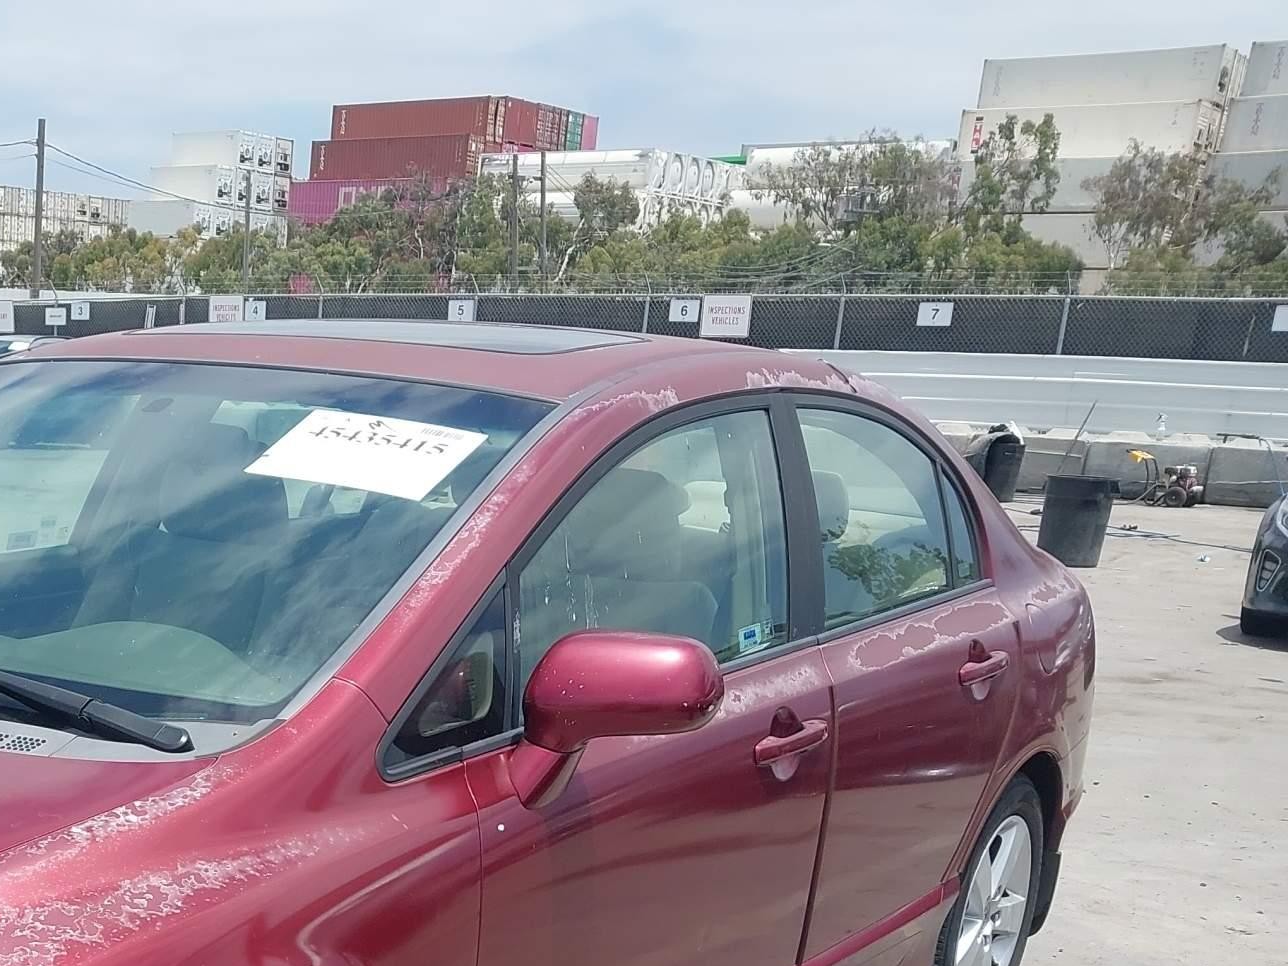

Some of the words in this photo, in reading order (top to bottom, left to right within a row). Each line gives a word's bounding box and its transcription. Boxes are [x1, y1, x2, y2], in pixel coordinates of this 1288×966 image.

[77, 306, 83, 316] 3
[251, 305, 258, 315] 4
[457, 304, 465, 316] 5
[680, 305, 688, 317] 6
[708, 306, 746, 315] INSPECTIONS
[931, 308, 940, 320] 7
[712, 316, 739, 326] VEHICLES
